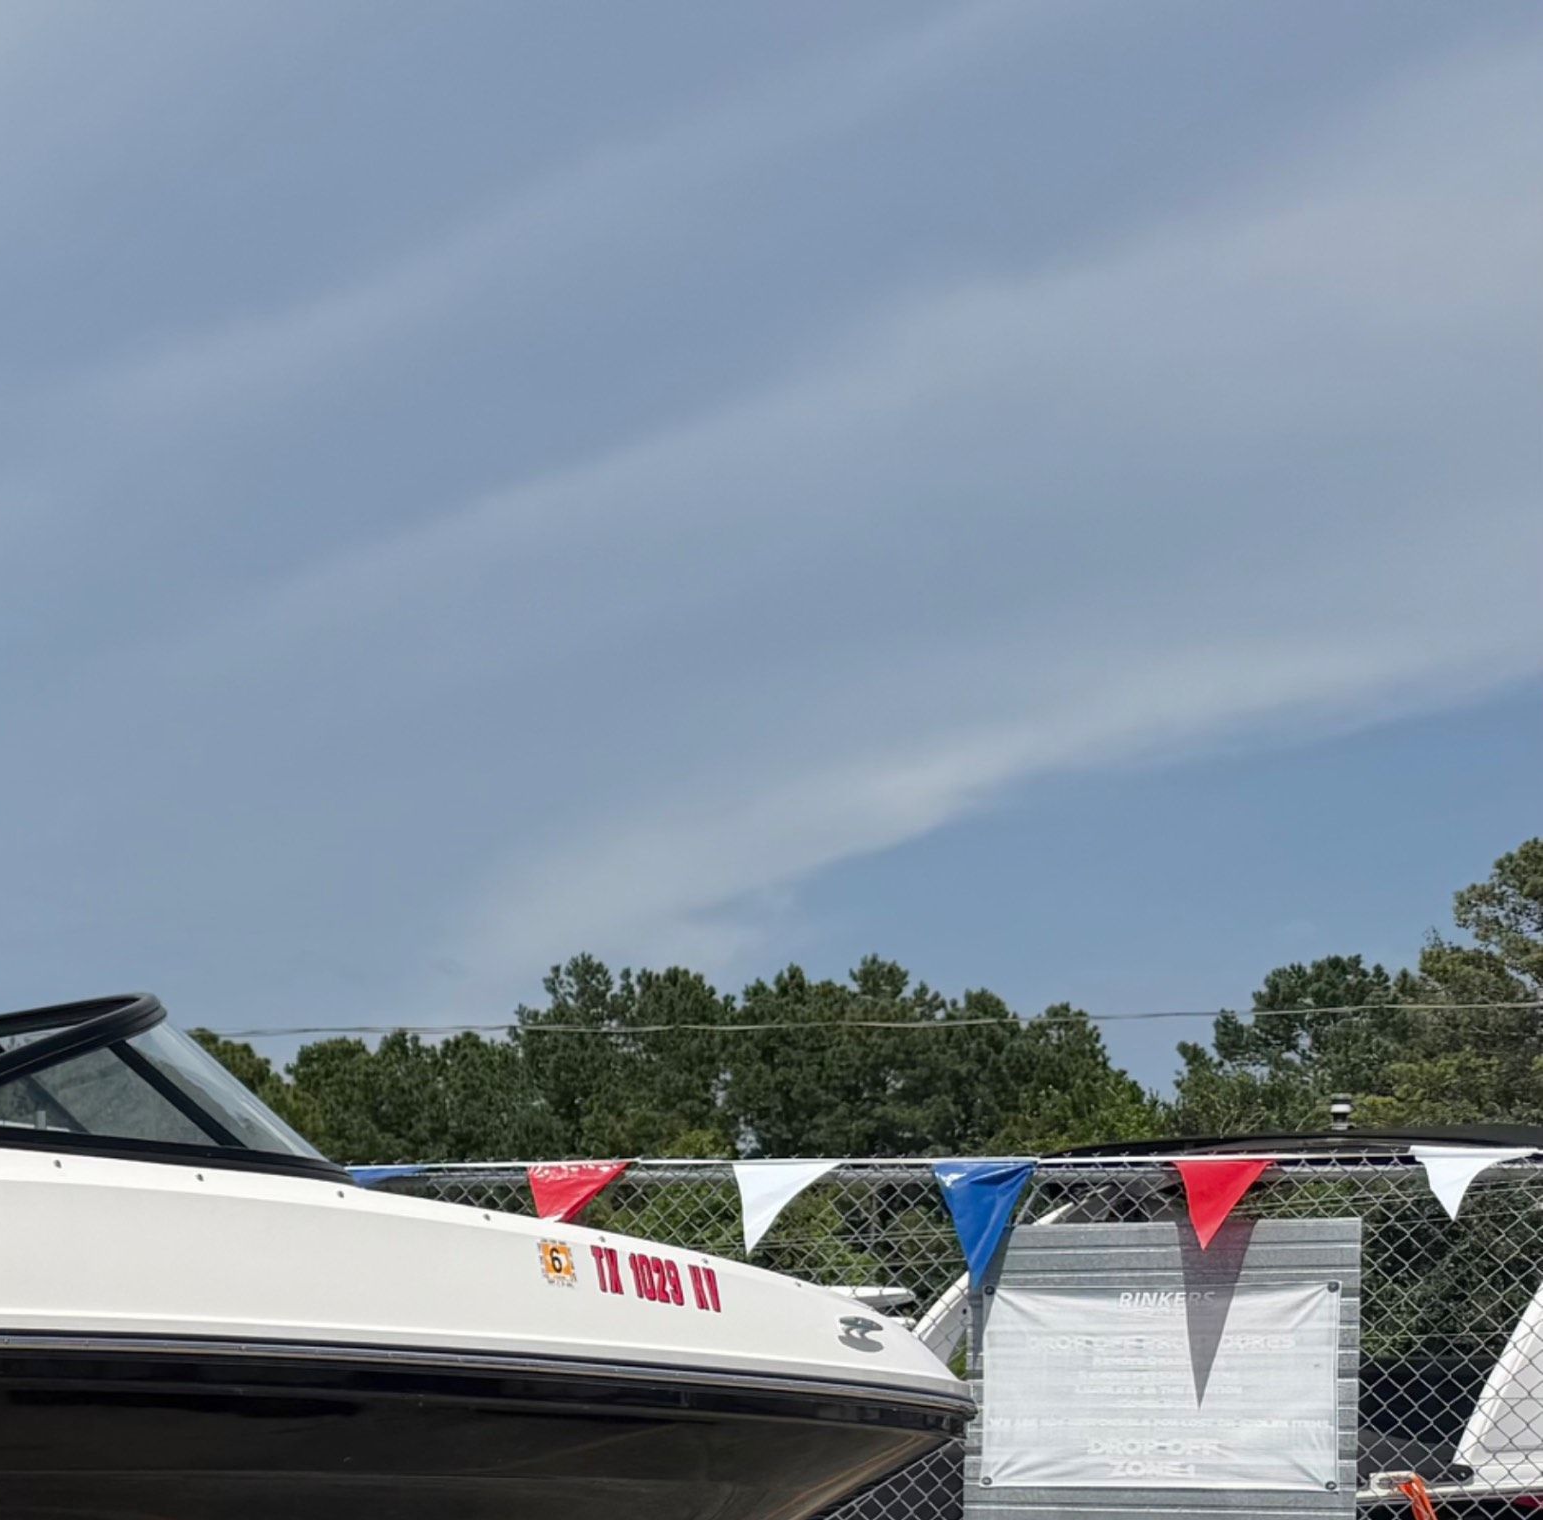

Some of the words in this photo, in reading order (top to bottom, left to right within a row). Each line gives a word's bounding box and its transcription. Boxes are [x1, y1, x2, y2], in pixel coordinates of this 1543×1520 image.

[549, 1247, 563, 1274] 6
[590, 1245, 624, 1295] TX
[628, 1252, 685, 1306] 1029
[1119, 1291, 1216, 1307] RINKERS
